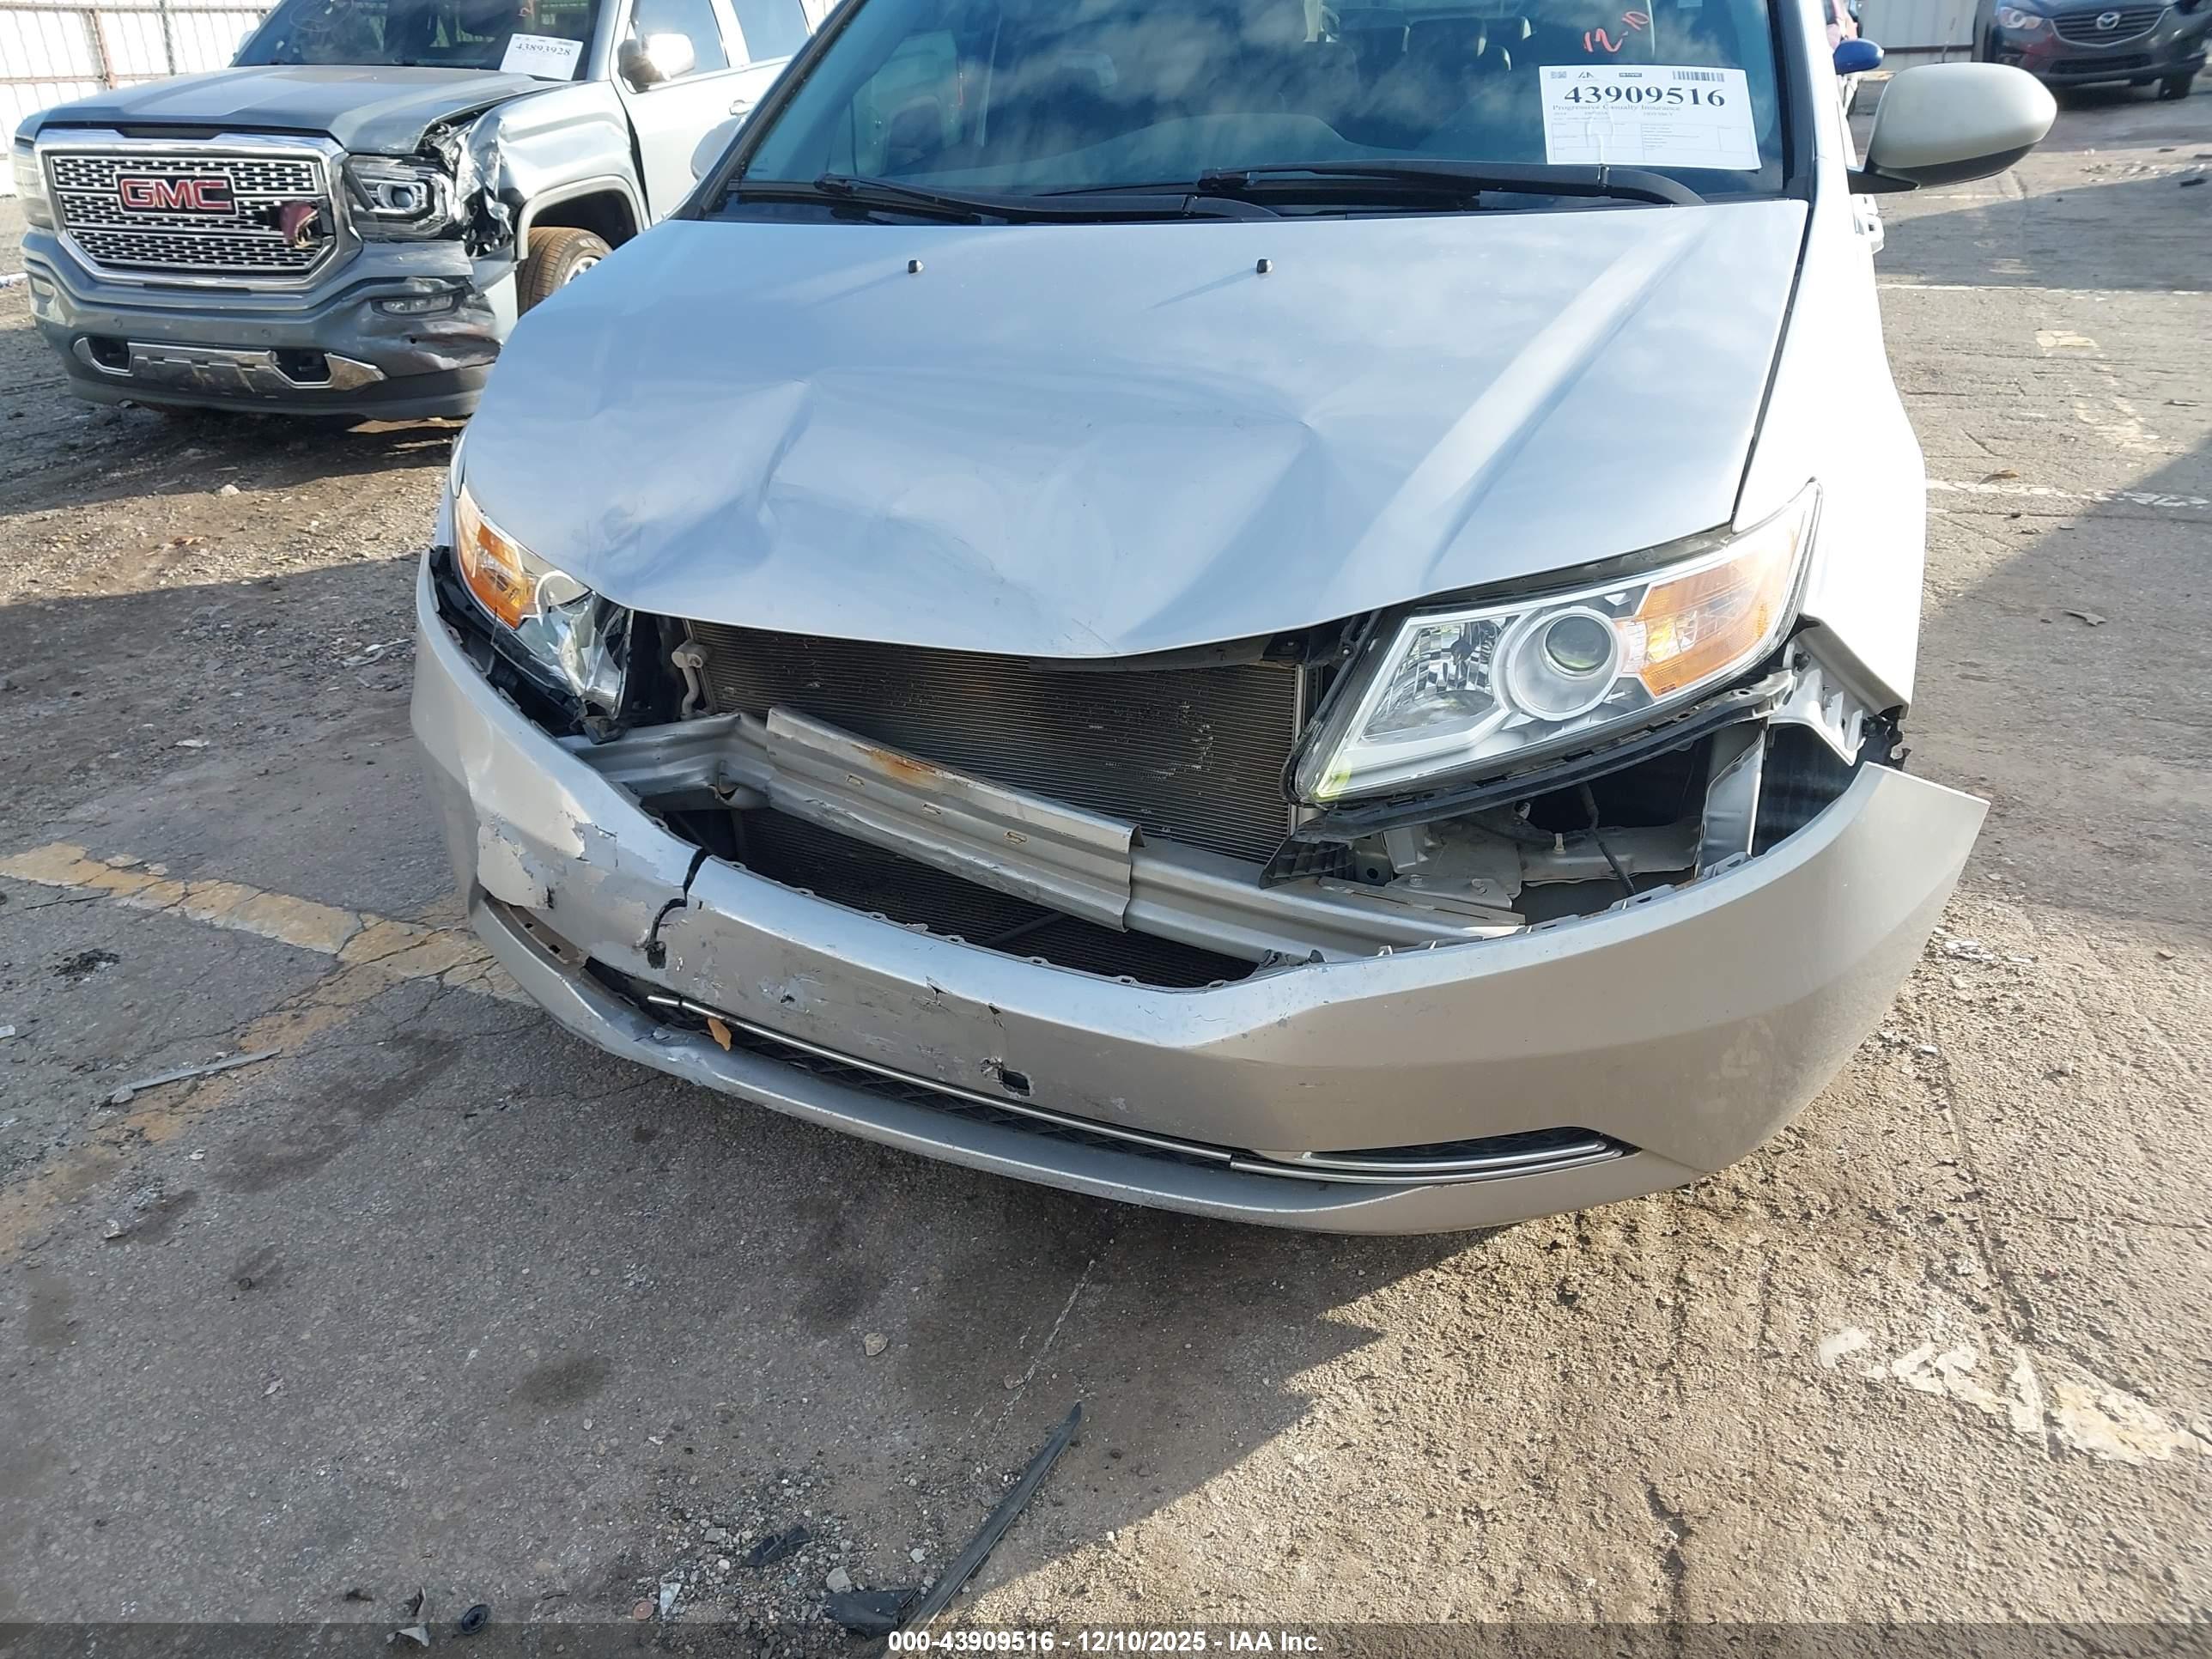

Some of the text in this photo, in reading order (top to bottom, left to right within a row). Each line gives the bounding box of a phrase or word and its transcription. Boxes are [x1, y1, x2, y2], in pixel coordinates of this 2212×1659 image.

[515, 42, 571, 56] 43893928
[1564, 85, 1725, 106] 43909516
[1602, 103, 1638, 112] Casualty
[119, 178, 234, 210] GMC
